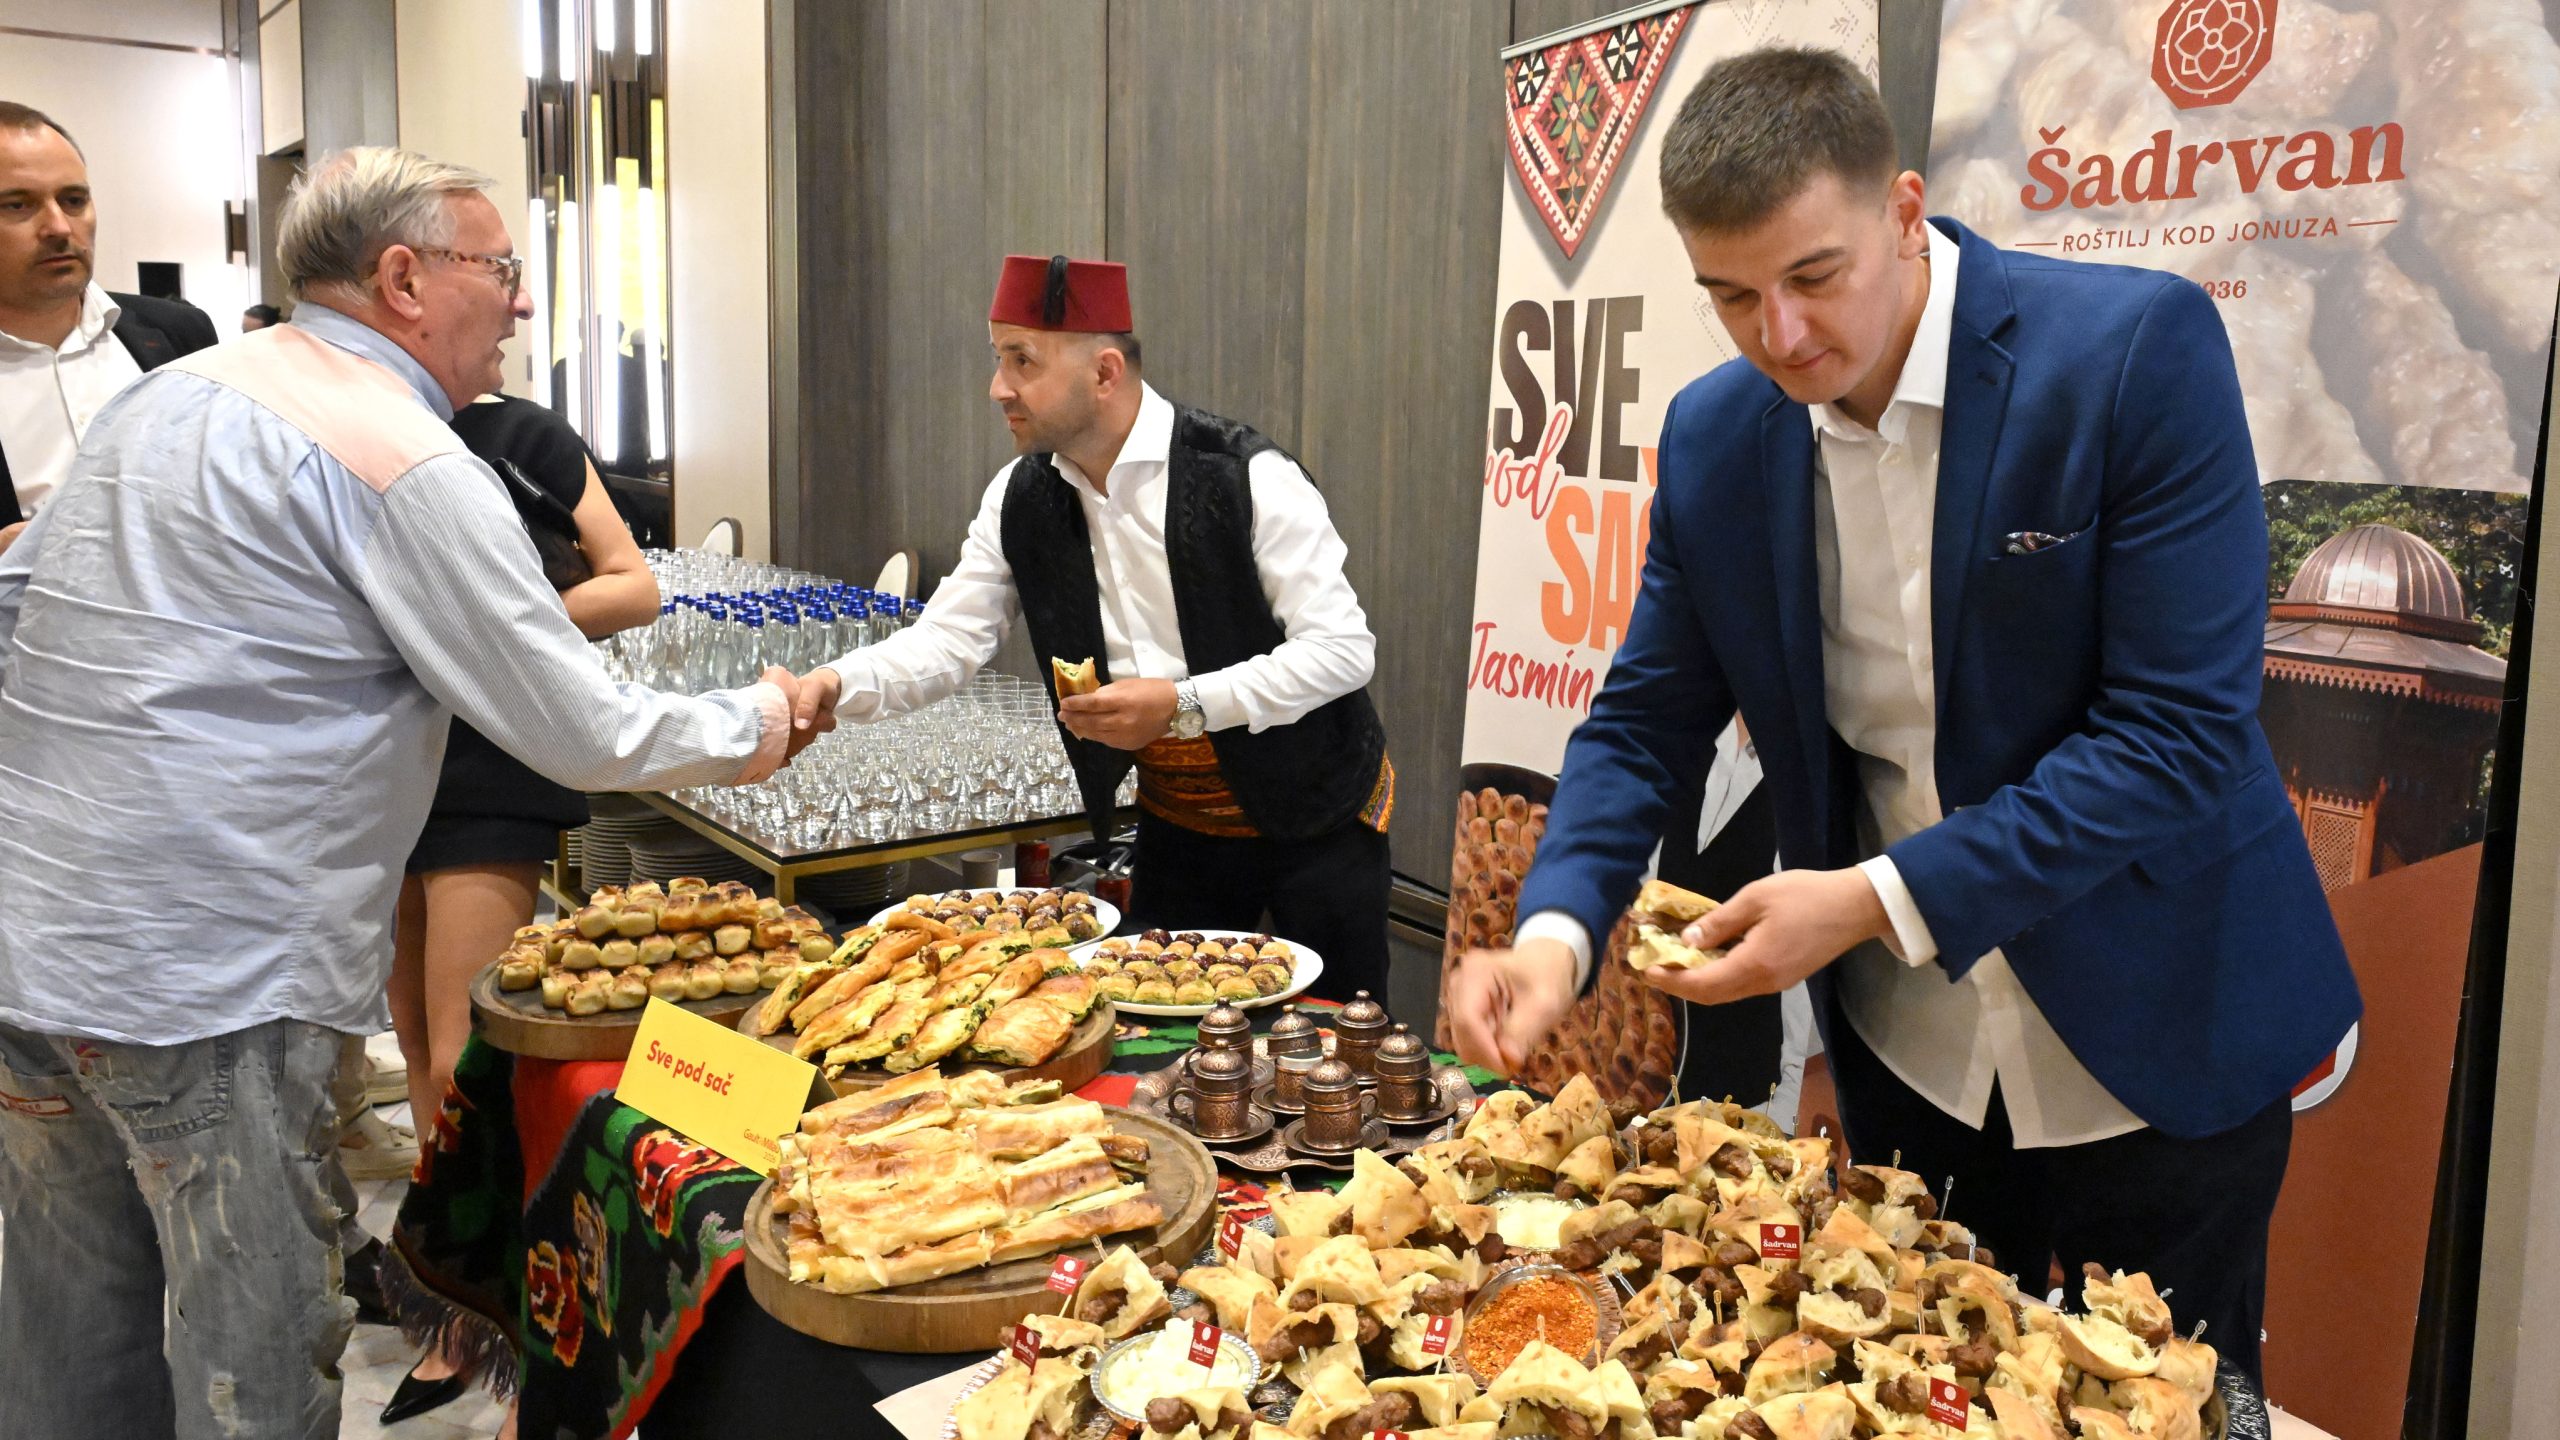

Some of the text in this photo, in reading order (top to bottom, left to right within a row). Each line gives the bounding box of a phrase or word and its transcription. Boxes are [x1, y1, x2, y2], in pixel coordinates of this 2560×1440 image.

[2020, 122, 2406, 212] Šadrvan
[2062, 217, 2339, 252] ROŠTILJ KOD JONUZA
[2202, 279, 2247, 300] 936
[1493, 295, 1643, 482] SVE
[646, 1040, 734, 1096] Sve pod sač
